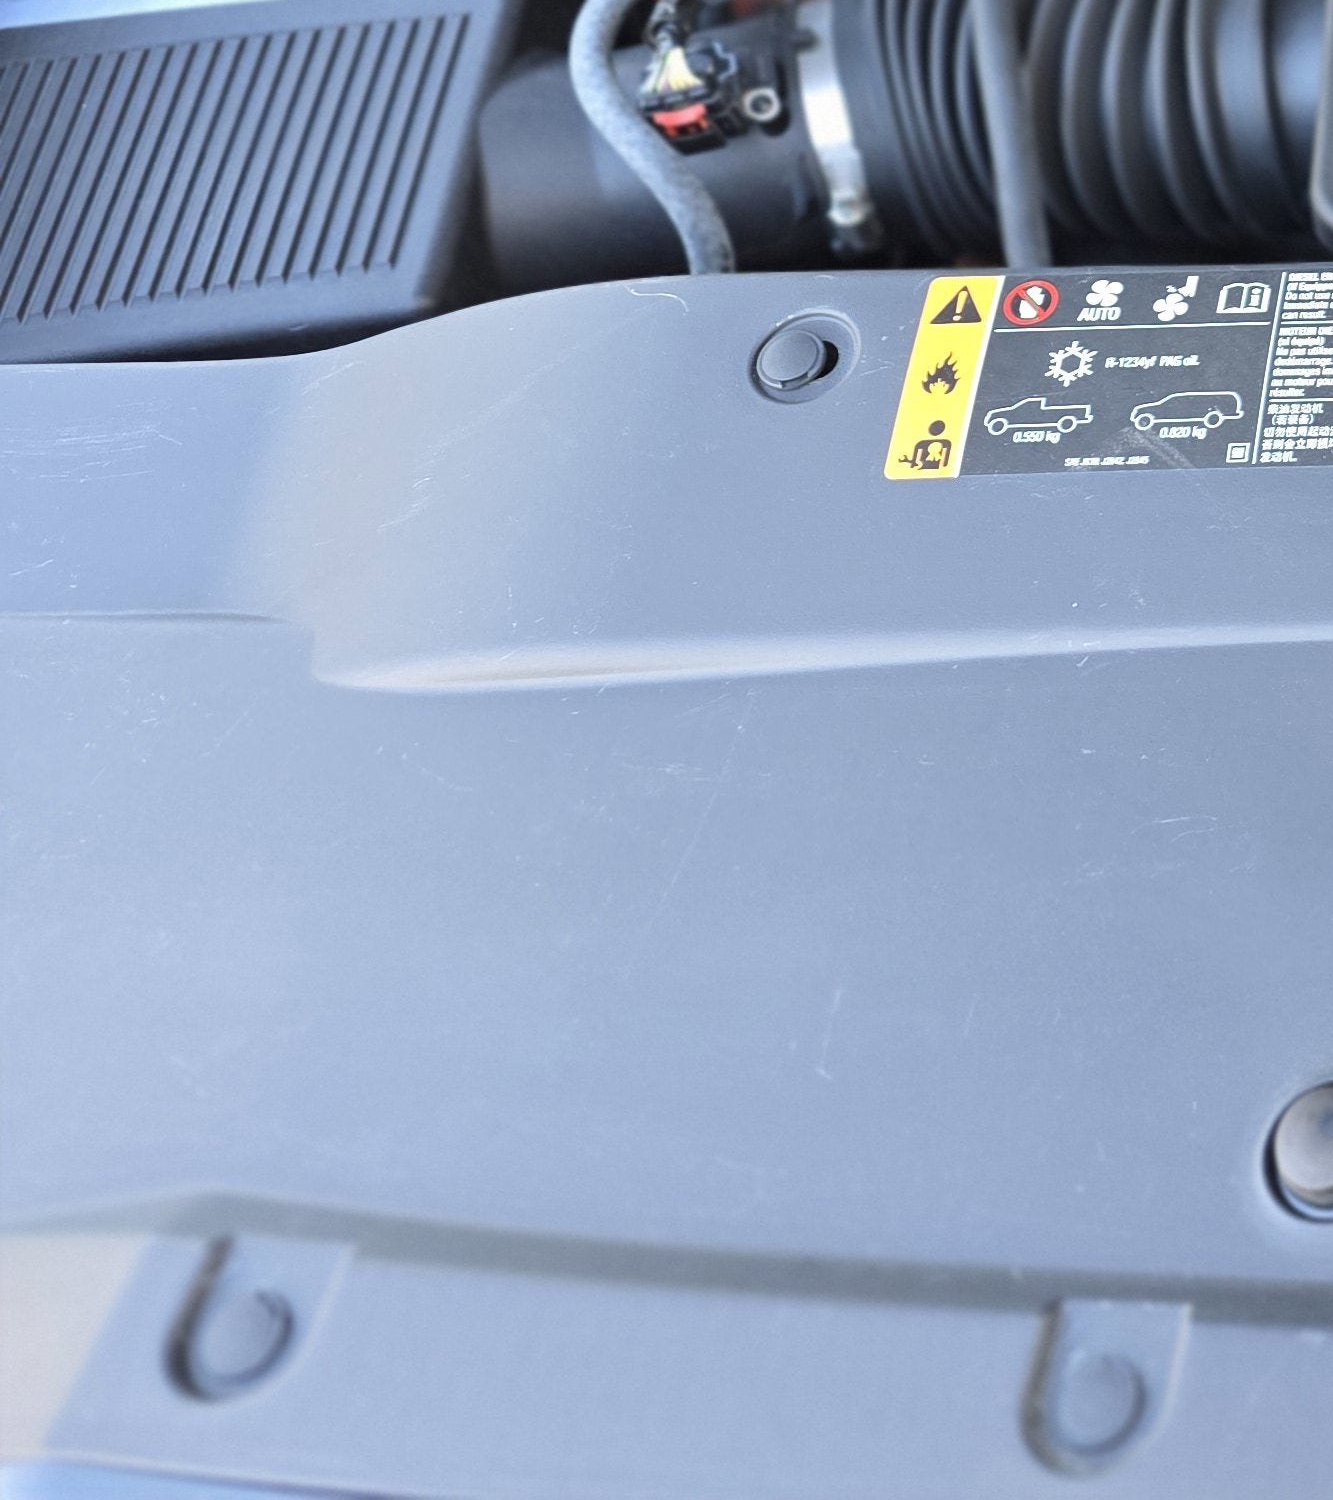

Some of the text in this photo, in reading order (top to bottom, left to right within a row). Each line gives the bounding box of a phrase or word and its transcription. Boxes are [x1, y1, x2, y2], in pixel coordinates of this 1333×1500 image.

[1285, 292, 1298, 300] Do
[1077, 307, 1121, 321] AUTO
[1045, 430, 1061, 444] kg
[1191, 425, 1207, 440] kg
